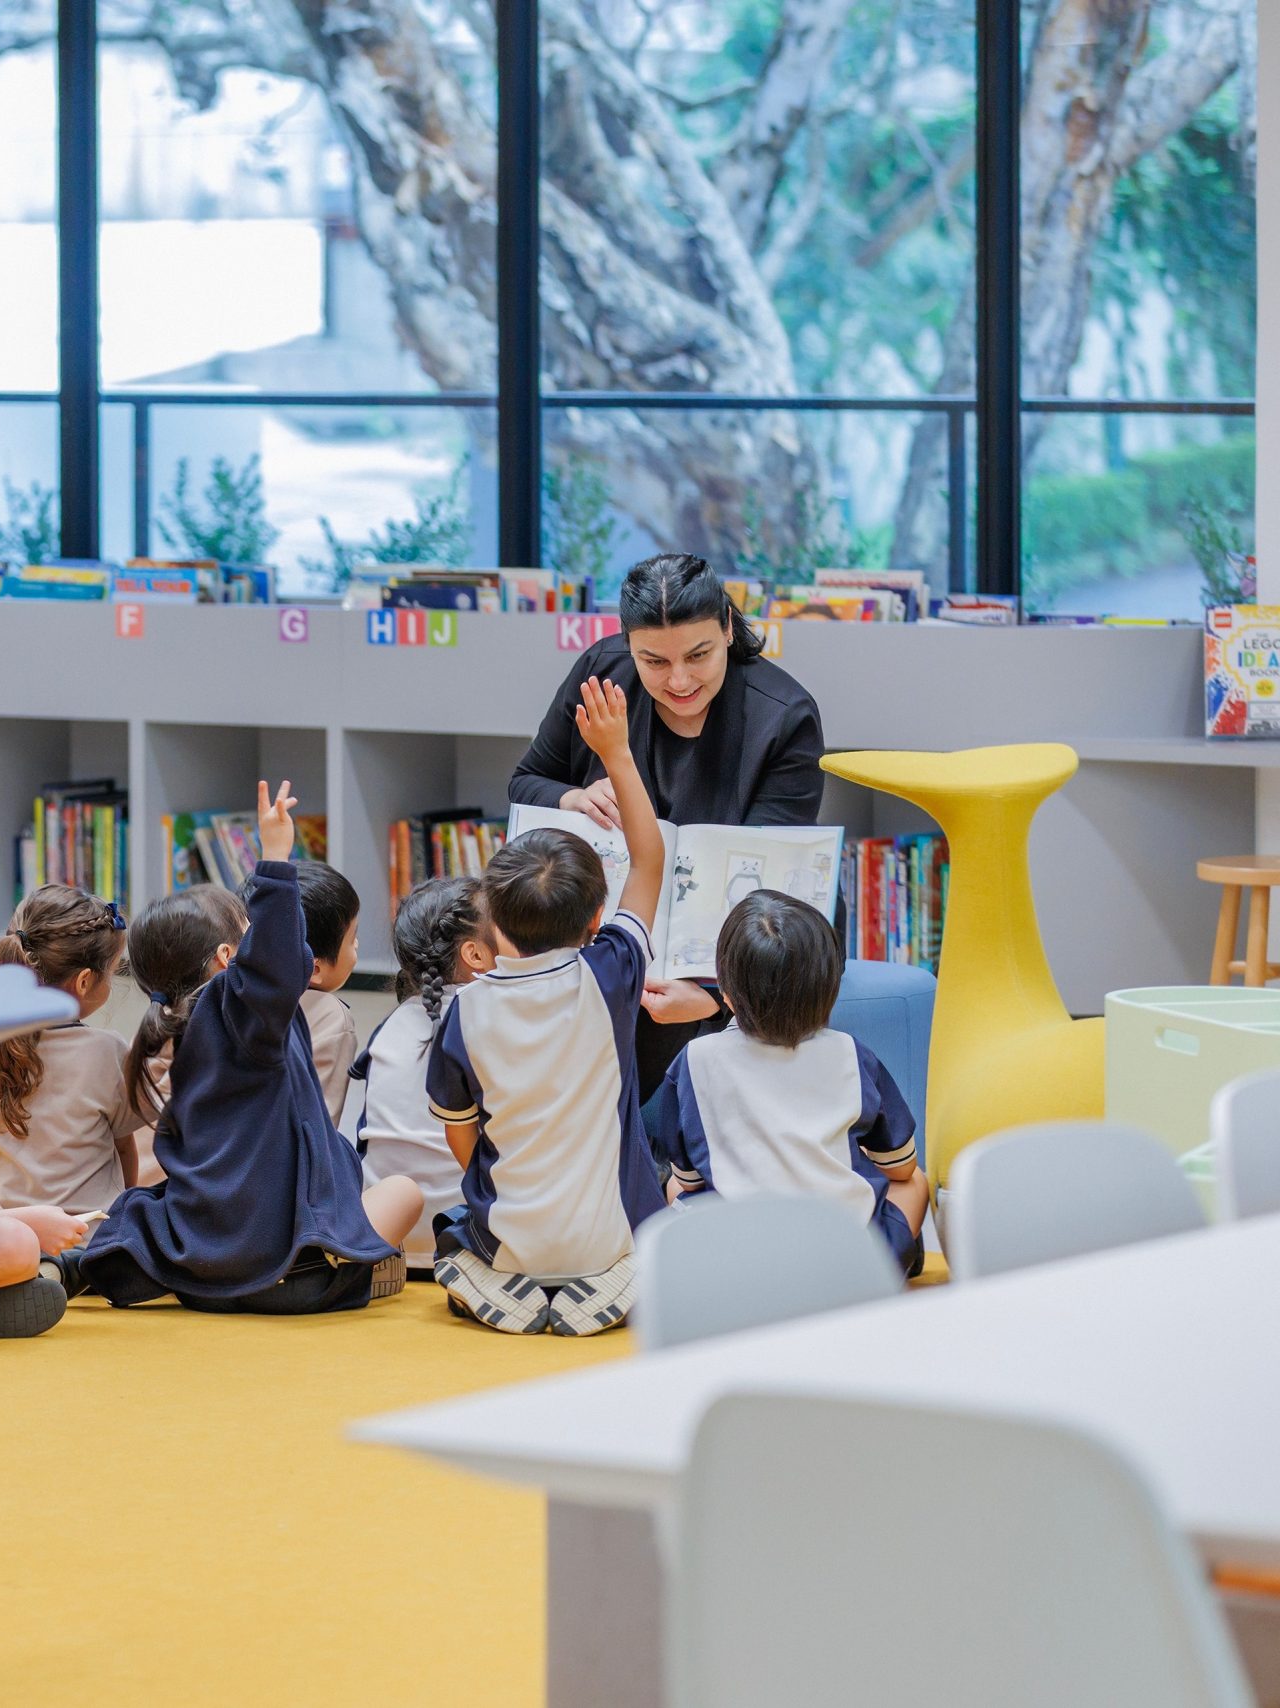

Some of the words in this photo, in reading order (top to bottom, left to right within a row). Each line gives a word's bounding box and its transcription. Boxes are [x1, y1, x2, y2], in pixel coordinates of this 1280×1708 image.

[121, 605, 139, 635] F
[280, 609, 306, 640] G
[1238, 651, 1279, 668] IDEA
[1249, 668, 1280, 677] BOOK
